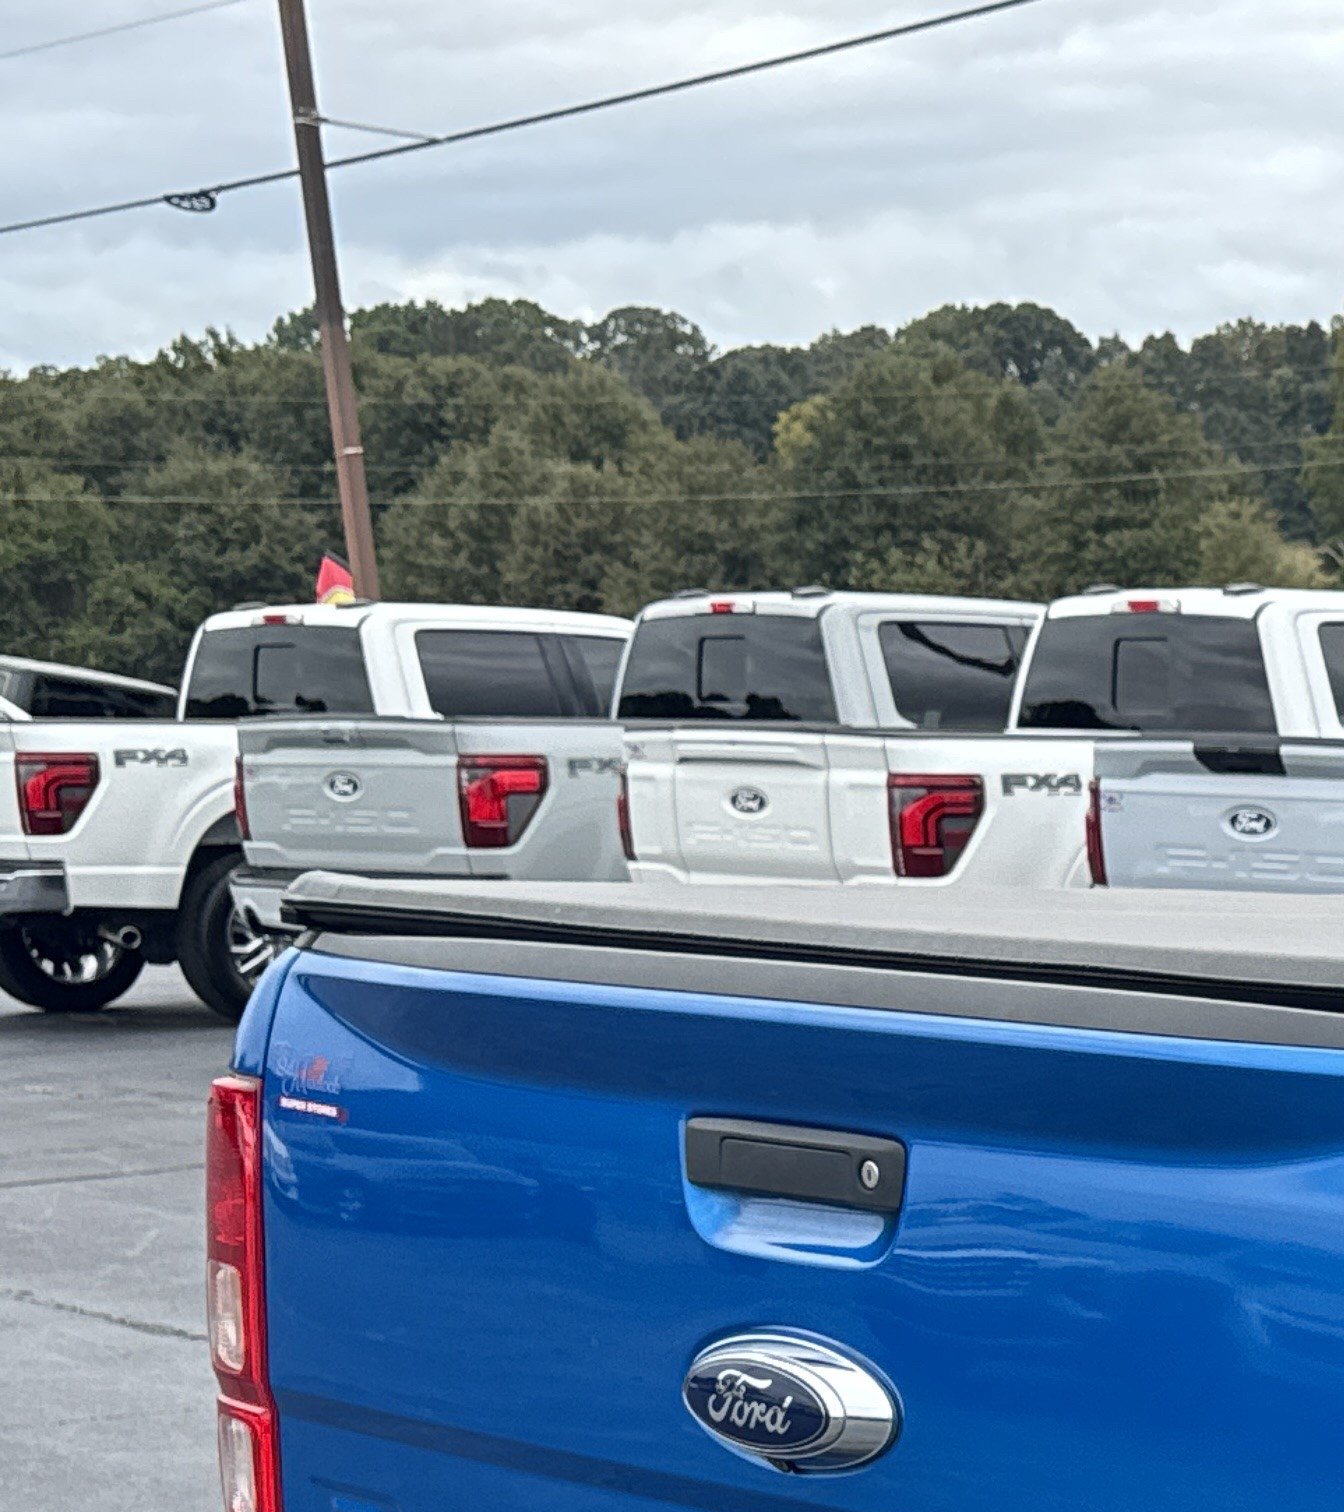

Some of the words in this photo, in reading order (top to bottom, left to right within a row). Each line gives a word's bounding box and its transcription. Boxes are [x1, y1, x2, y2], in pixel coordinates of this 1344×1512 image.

[114, 748, 188, 767] FX4
[1000, 773, 1082, 796] FX4
[707, 1368, 794, 1436] Ford
